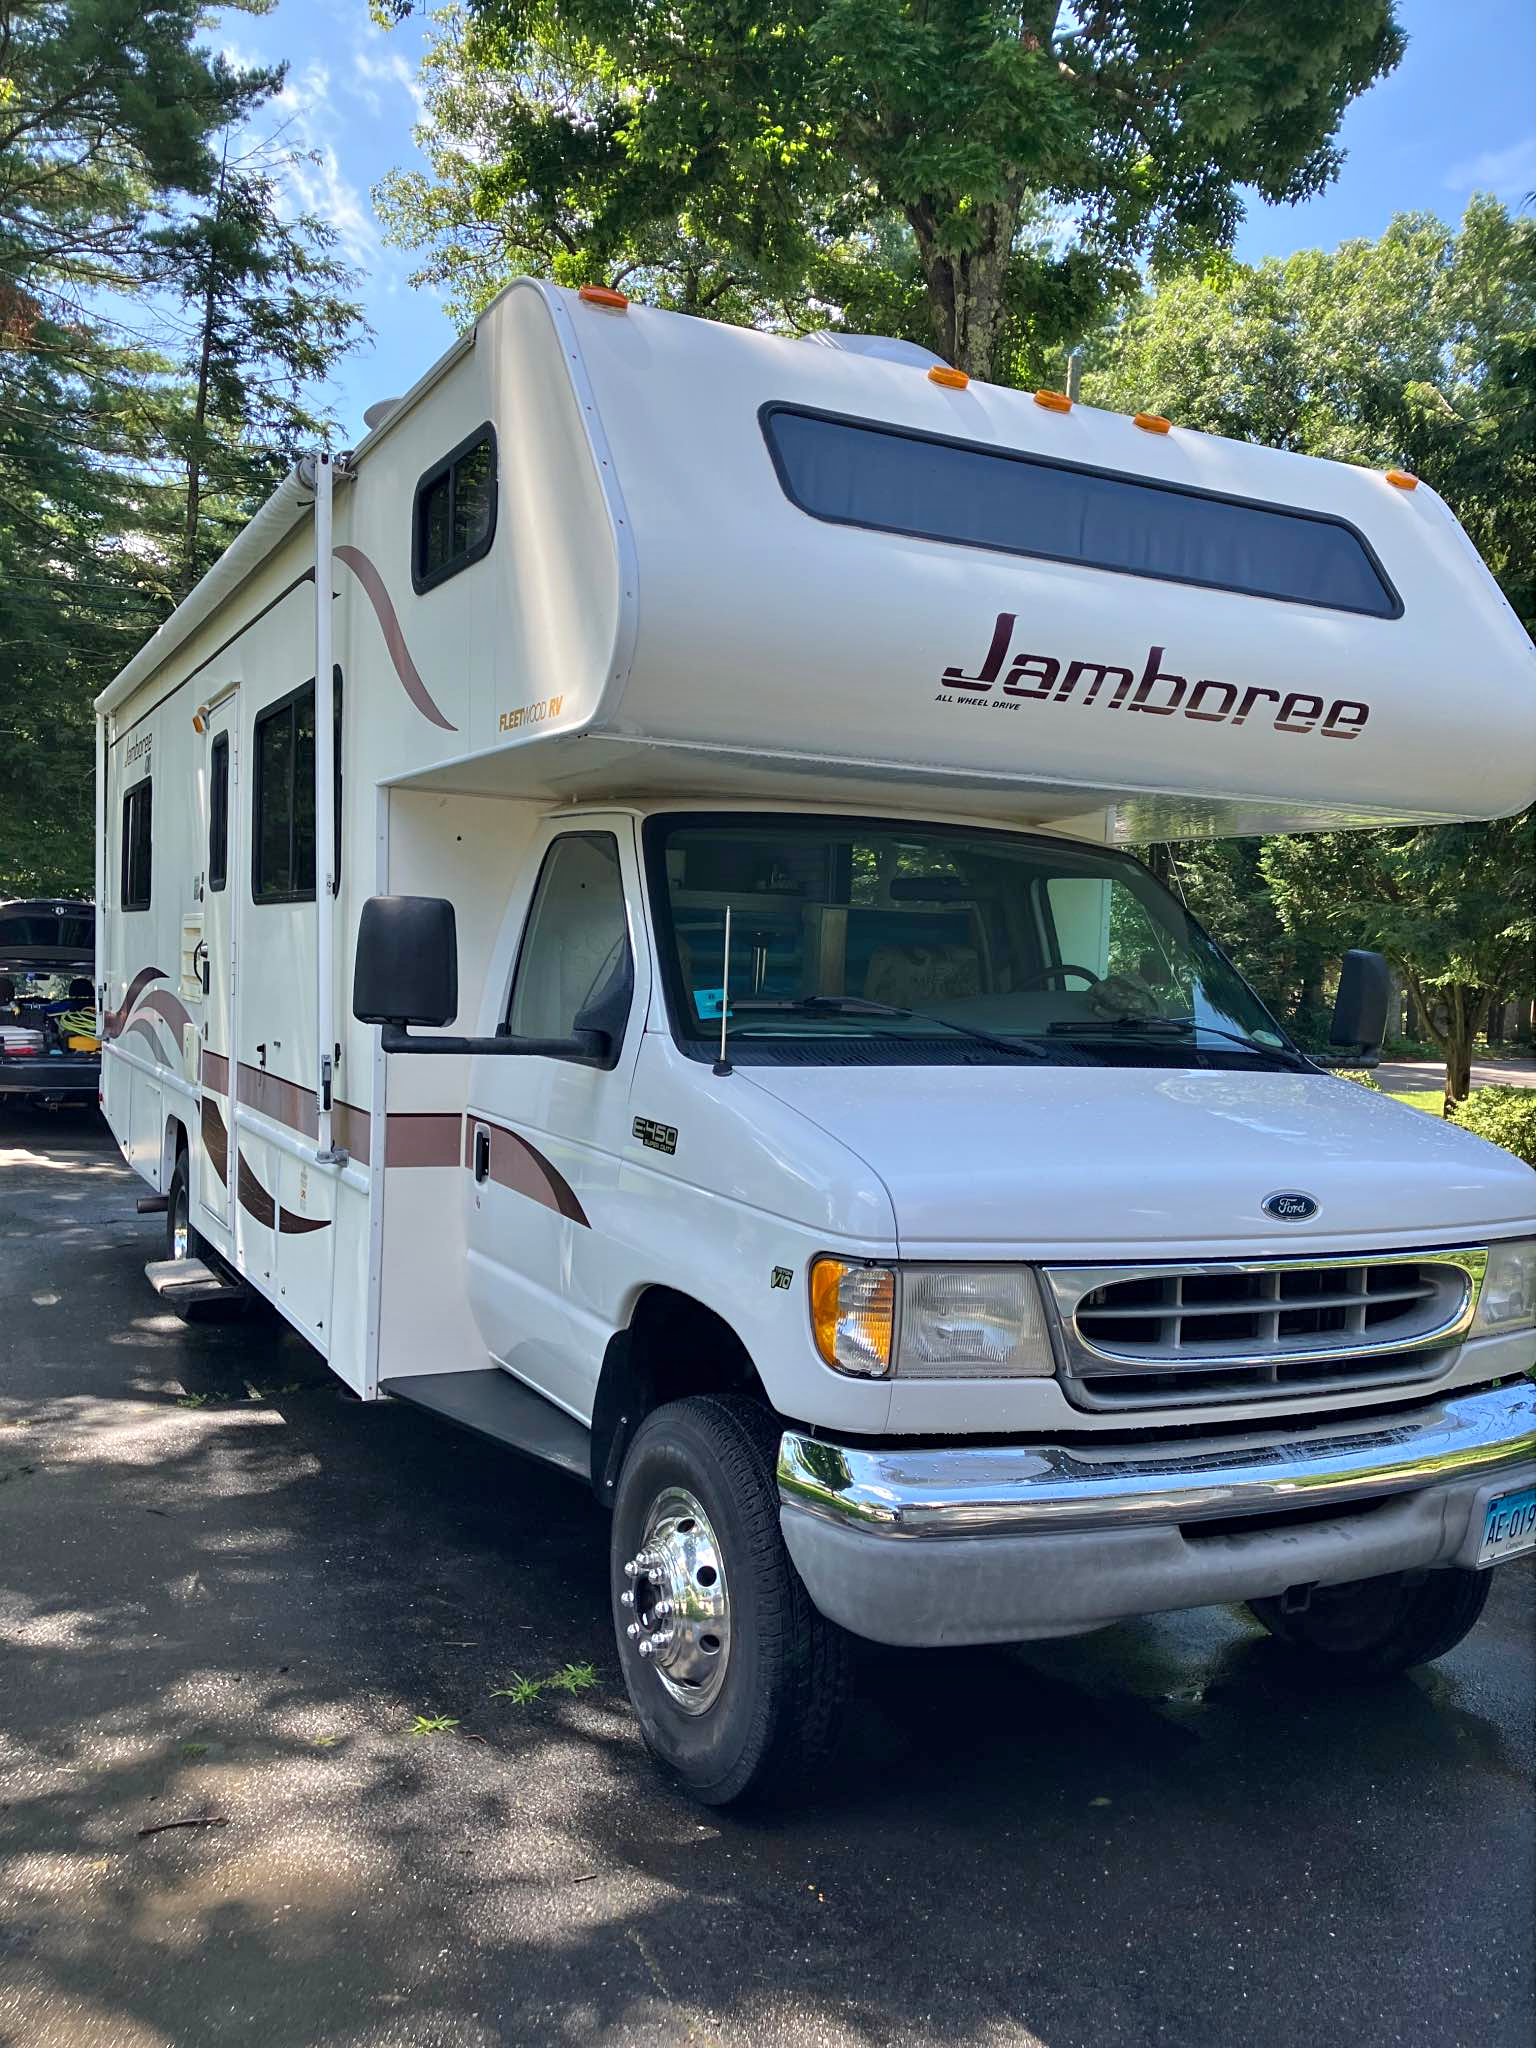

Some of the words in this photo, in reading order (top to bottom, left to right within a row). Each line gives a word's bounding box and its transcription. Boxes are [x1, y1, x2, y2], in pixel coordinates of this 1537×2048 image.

[941, 612, 1369, 740] Jamboree
[499, 701, 546, 732] FLEETWOOD
[549, 696, 564, 718] RV
[935, 694, 953, 703] ALL
[957, 696, 989, 707] WHEEL
[992, 700, 1021, 711] DRIVE
[634, 1118, 677, 1147] E450
[1278, 1198, 1306, 1214] Ford
[772, 1271, 791, 1288] V10
